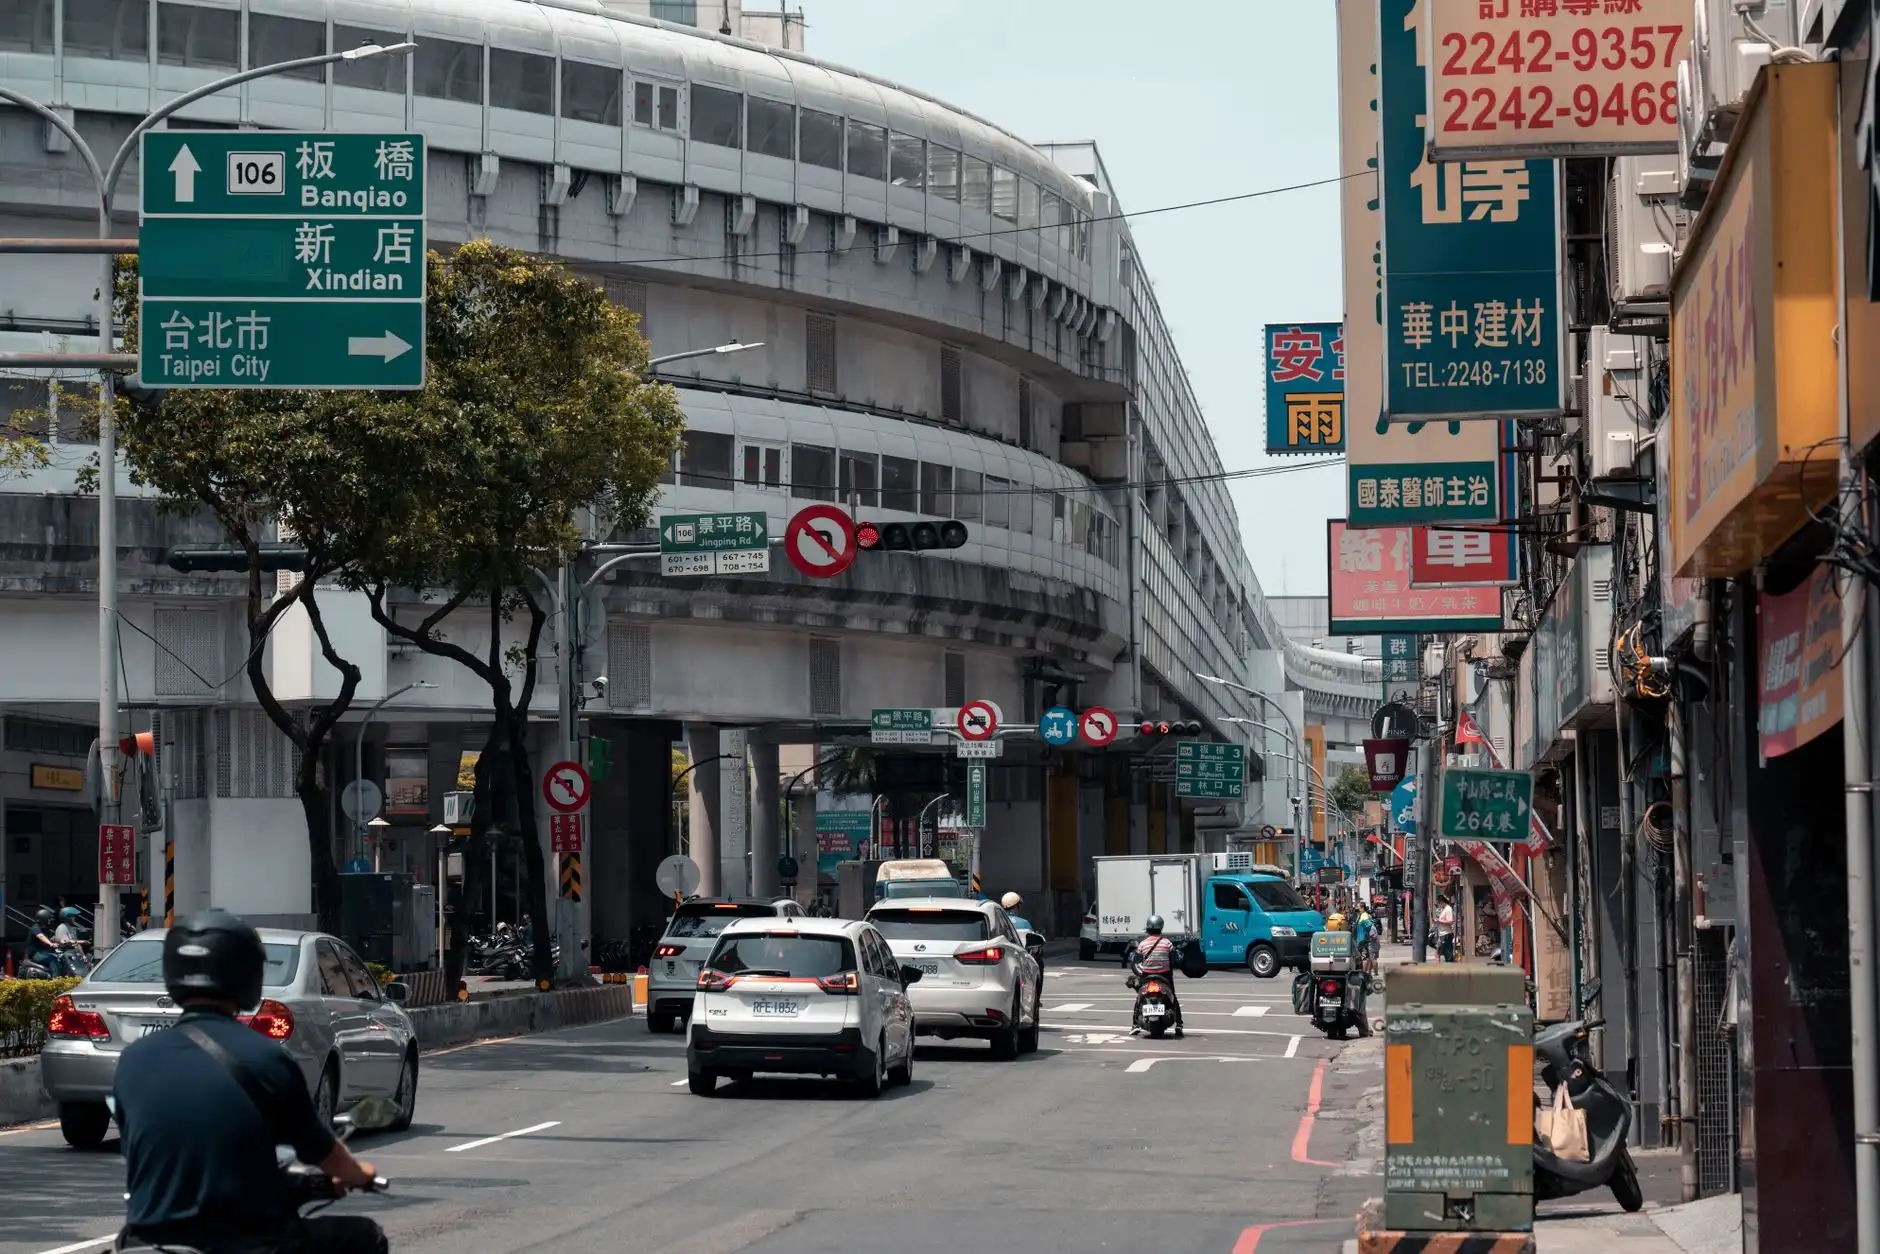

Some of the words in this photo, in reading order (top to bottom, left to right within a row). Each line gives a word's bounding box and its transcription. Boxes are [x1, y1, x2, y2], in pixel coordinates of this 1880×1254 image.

[1441, 25, 1683, 76] 2242-9357
[1442, 81, 1679, 132] 2242-9468
[236, 162, 276, 185] 106
[295, 140, 415, 181] 板橋
[301, 185, 407, 212] Banqiao
[294, 222, 415, 264] 新店
[305, 268, 403, 290] Xindian
[160, 310, 272, 350] 台北市
[1400, 297, 1545, 350] 華中建材
[160, 354, 221, 382] Taipei
[231, 354, 270, 382] City
[1401, 359, 1547, 388] TEL:2248-7138
[1357, 475, 1489, 509] 國泰醫師主治
[677, 529, 693, 538] 106
[697, 516, 752, 534] 景平路
[699, 536, 740, 548] Jingping
[1232, 748, 1240, 758] 3
[1231, 766, 1240, 777] 7
[1229, 784, 1240, 794] 16
[1456, 776, 1516, 803] 中山路二段
